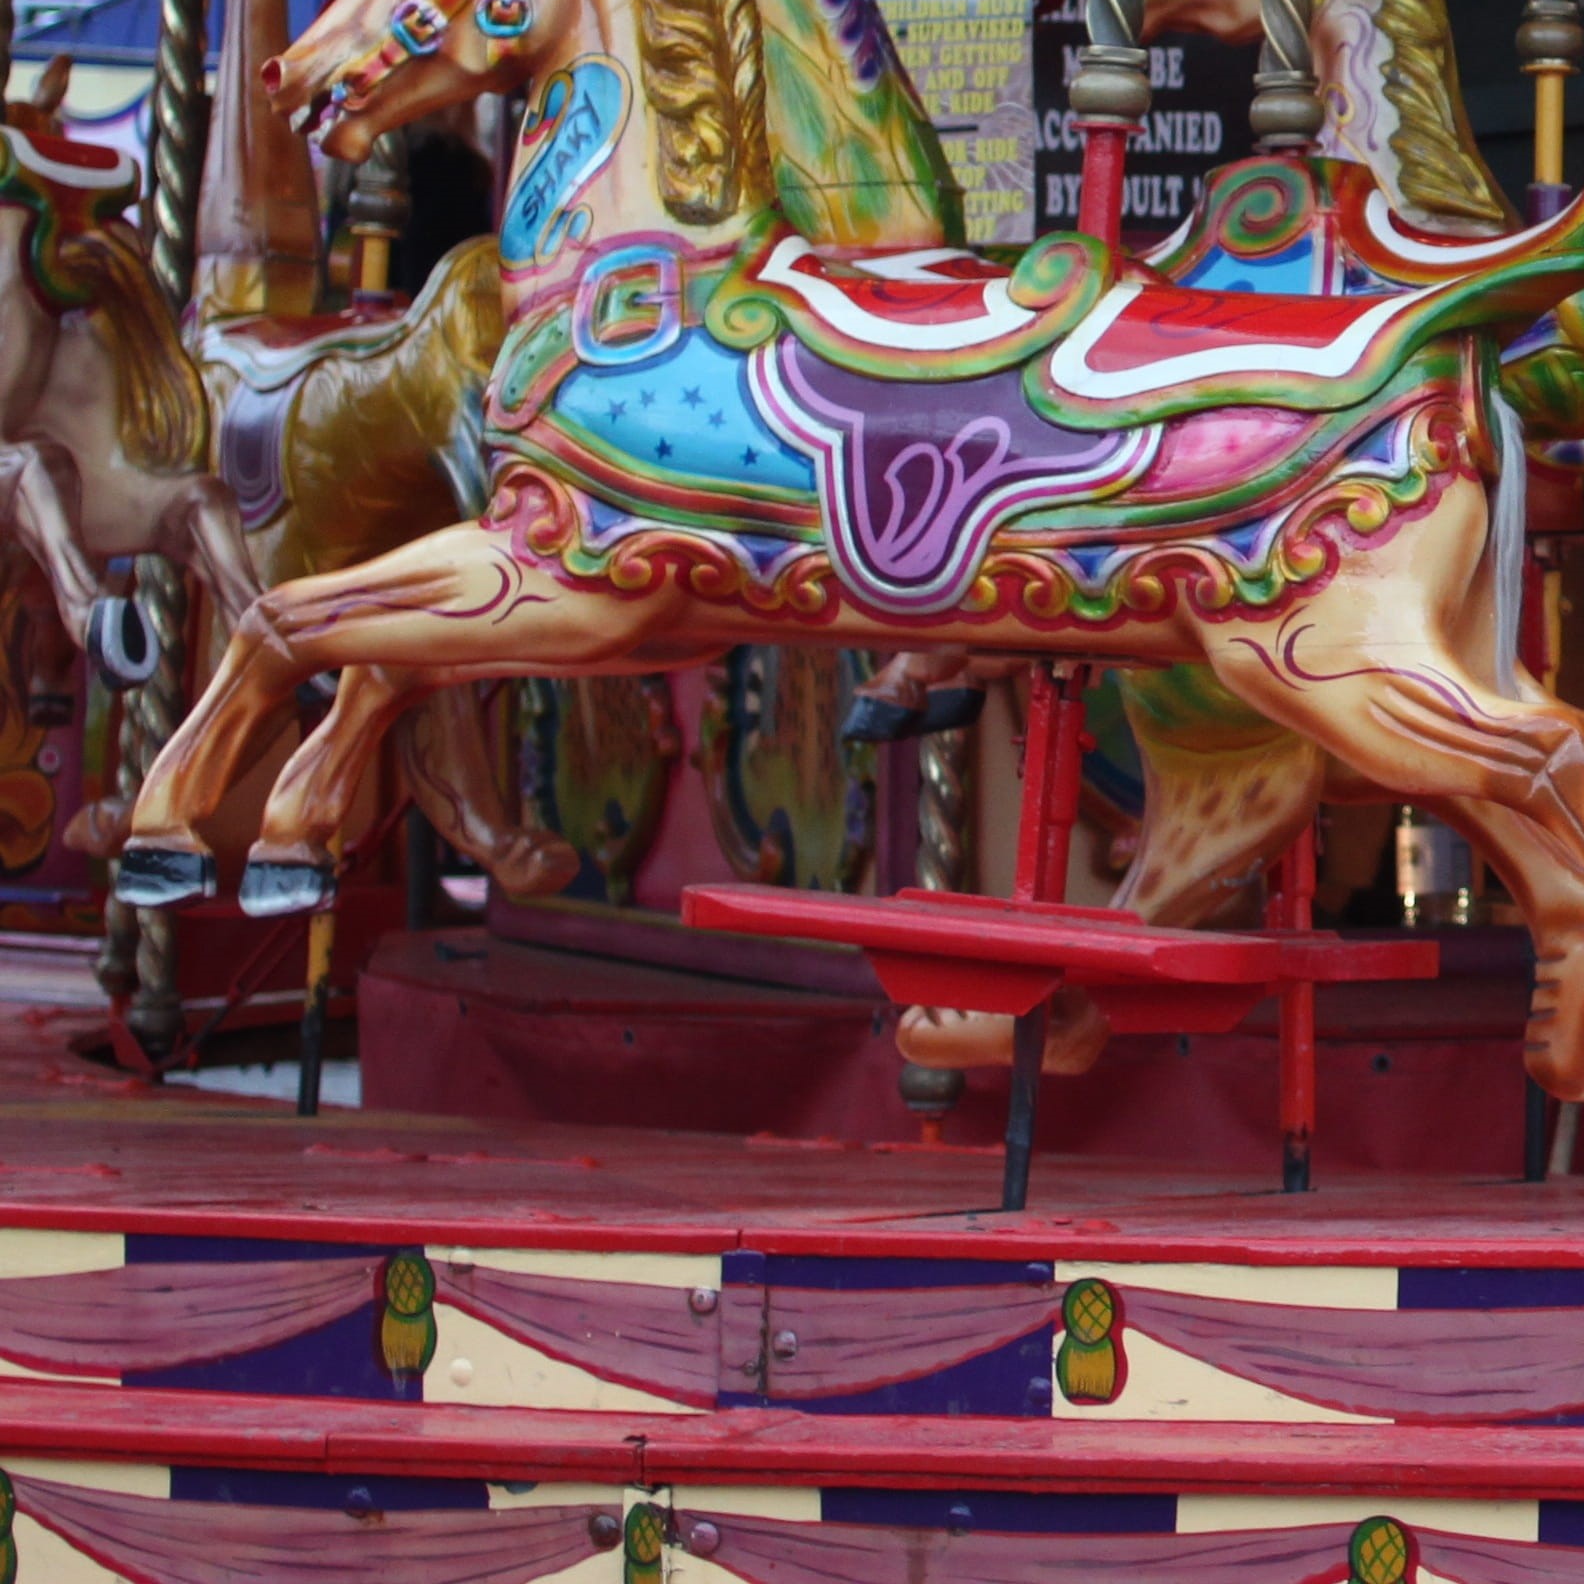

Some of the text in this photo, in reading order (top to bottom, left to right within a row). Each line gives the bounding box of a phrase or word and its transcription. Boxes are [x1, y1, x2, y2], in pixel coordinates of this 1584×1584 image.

[907, 18, 1026, 44] SUPERVISED
[940, 41, 1024, 66] GETTING
[926, 67, 966, 91] AND
[973, 66, 1010, 87] OFF
[1150, 47, 1185, 89] BE
[950, 91, 996, 114] RIDE
[521, 90, 600, 230] SHAKY
[975, 136, 1018, 163] RIDE
[1045, 173, 1082, 216] BY
